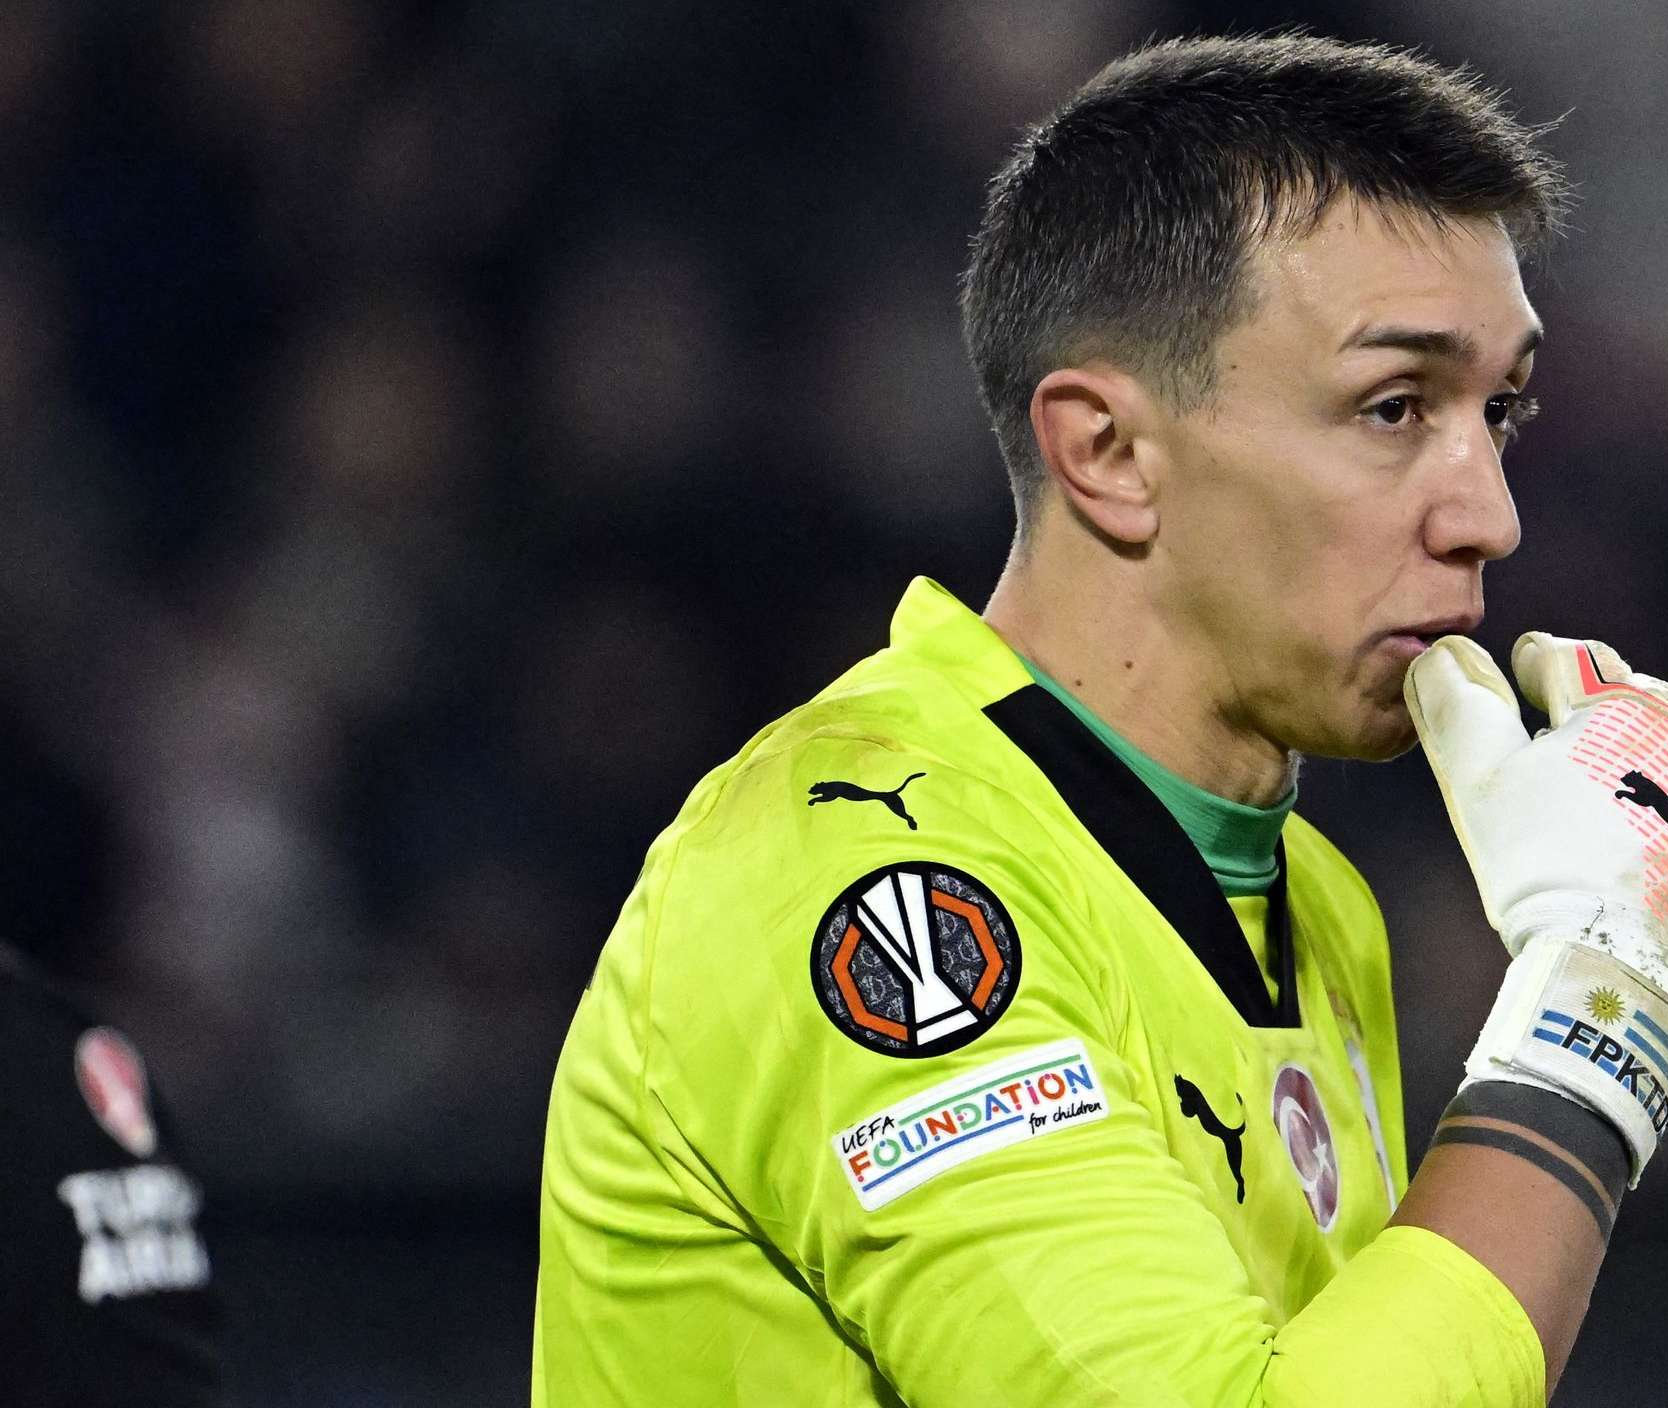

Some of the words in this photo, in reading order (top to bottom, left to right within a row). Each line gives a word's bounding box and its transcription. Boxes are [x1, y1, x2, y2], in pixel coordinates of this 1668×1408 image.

[842, 1115, 896, 1153] UEFA
[848, 1063, 1094, 1182] FOUNDATION
[1028, 1110, 1047, 1134] for
[1052, 1101, 1102, 1123] children
